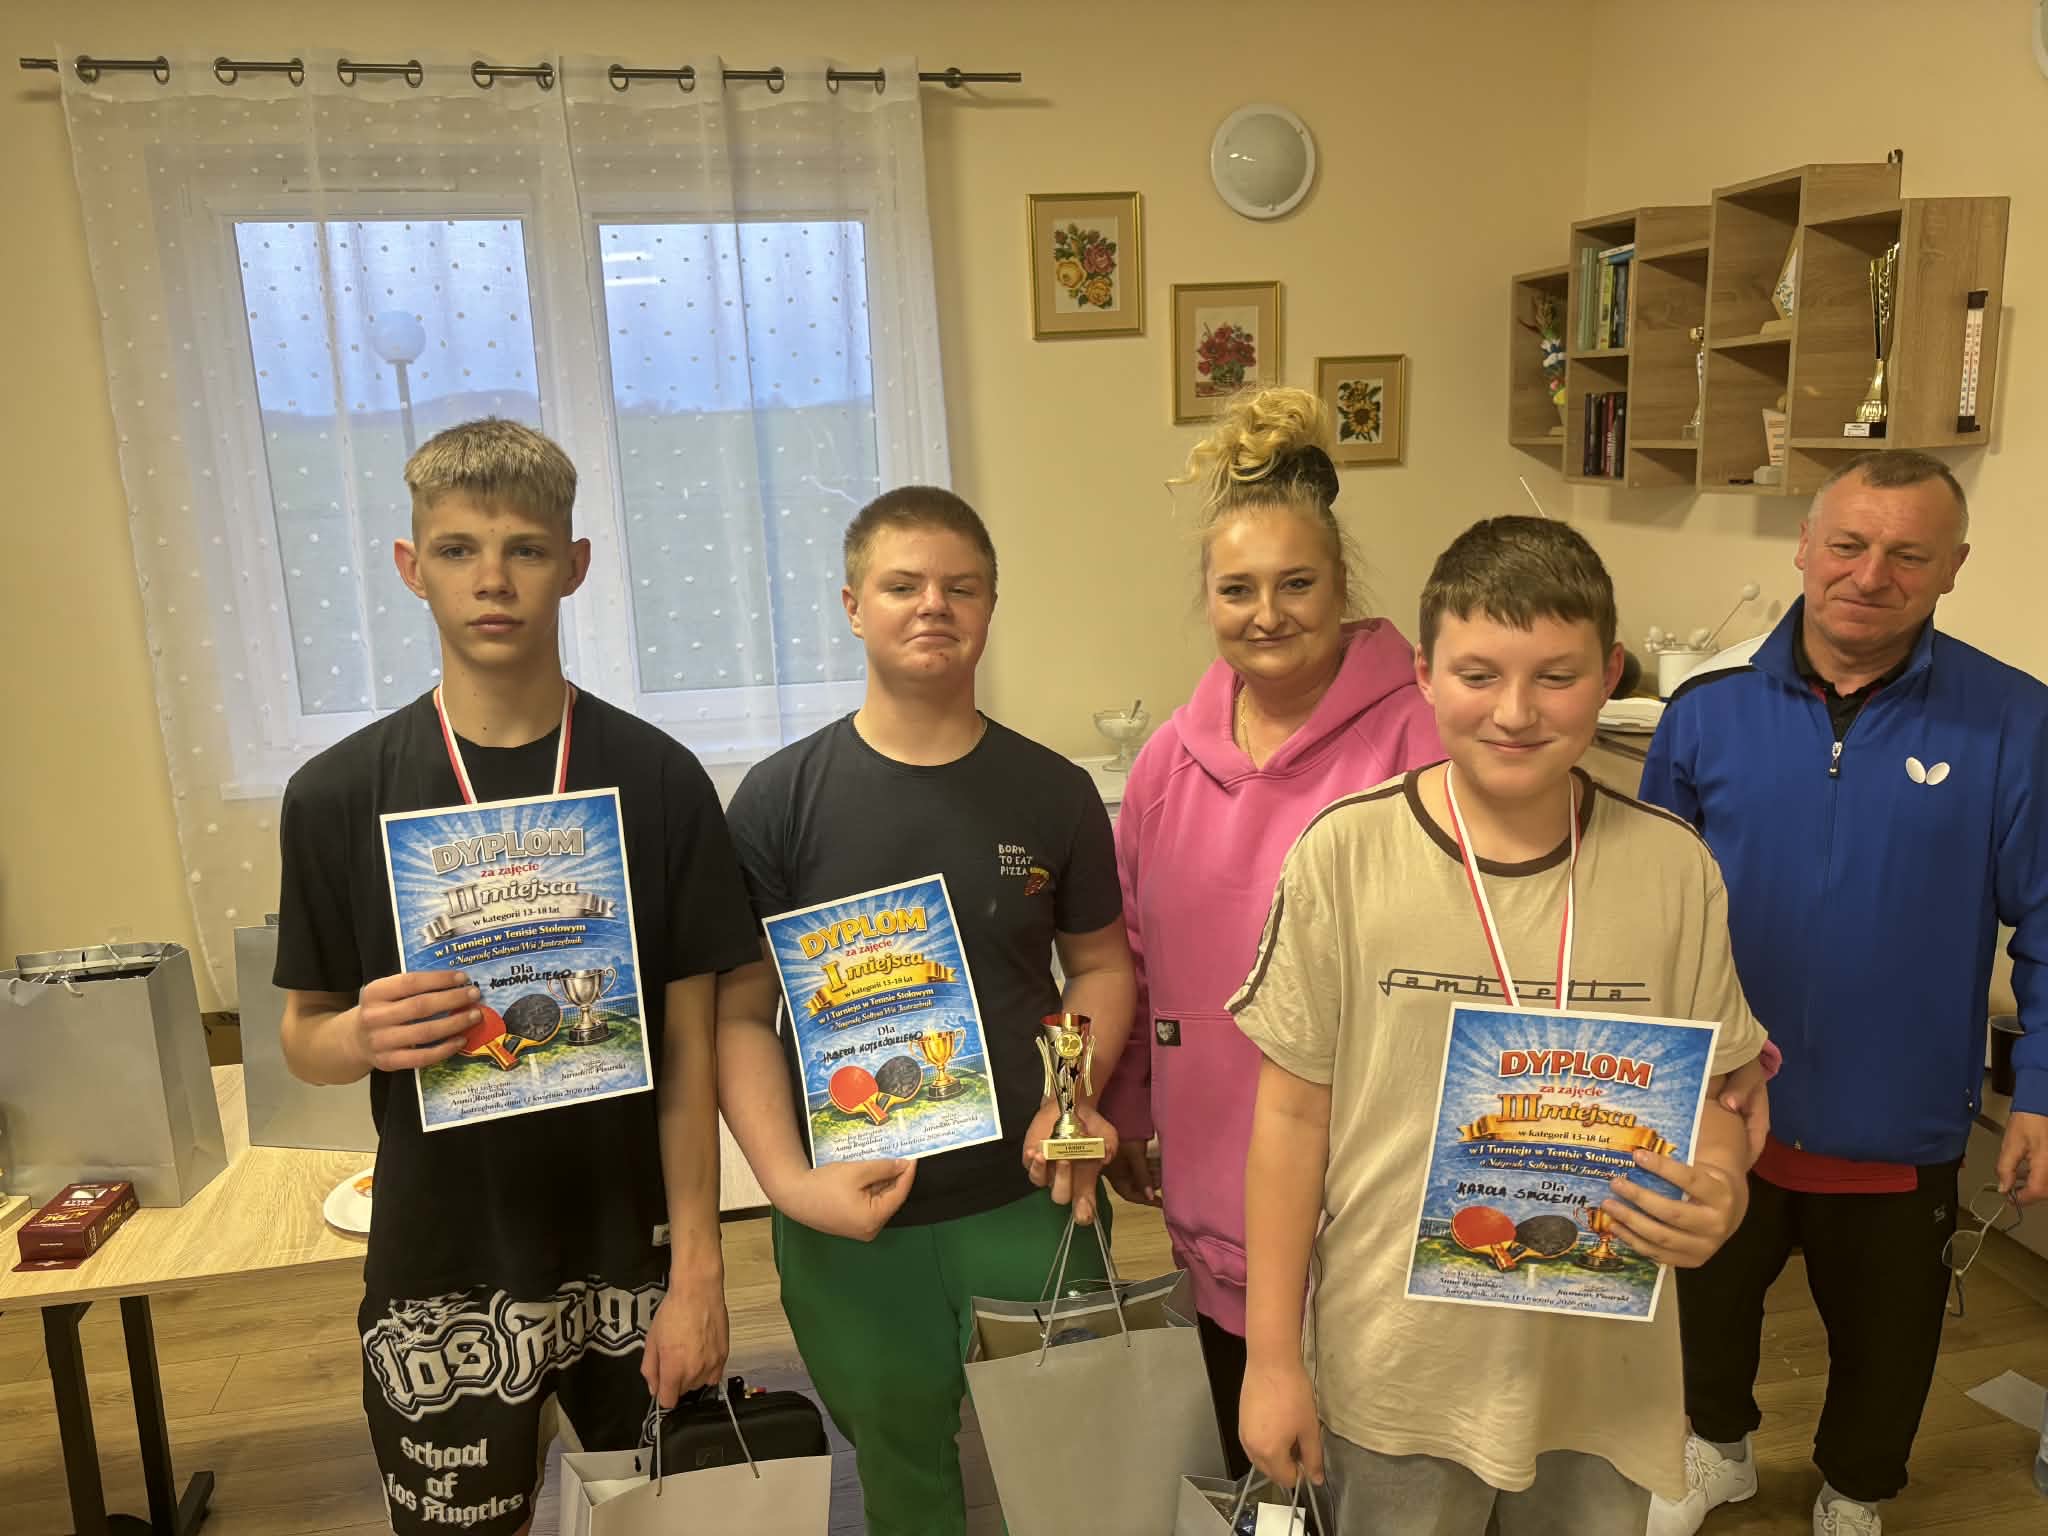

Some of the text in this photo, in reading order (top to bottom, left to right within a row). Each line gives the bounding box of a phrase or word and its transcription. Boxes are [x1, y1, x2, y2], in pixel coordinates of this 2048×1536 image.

[431, 827, 585, 875] DYPLOM
[998, 843, 1026, 854] BORN
[998, 855, 1034, 865] TO EAT
[480, 863, 540, 878] za zajęcie
[1000, 866, 1029, 876] PIZZA
[444, 878, 578, 918] II miejsca
[472, 919, 482, 927] w
[482, 911, 521, 925] kategorii
[546, 906, 560, 914] lat
[800, 907, 927, 959] DYPLOM
[434, 949, 444, 958] w
[451, 936, 492, 952] Turnieju
[494, 933, 503, 941] w
[503, 926, 538, 940] Tenisie
[845, 939, 893, 957] za zajęcie
[510, 963, 534, 976] Dla
[822, 952, 925, 992] I miejsca
[903, 975, 913, 983] lat
[878, 1025, 896, 1036] Dla
[1498, 1049, 1654, 1089] DYPLOM
[1539, 1085, 1604, 1098] za zajęcie
[1496, 1093, 1637, 1128] III miejsca
[1527, 1128, 1570, 1141] kategorii
[1572, 1132, 1596, 1143] 13-18
[1598, 1135, 1611, 1144] lat
[1469, 1147, 1479, 1155] w
[1487, 1144, 1532, 1158] Turnieju
[1535, 1149, 1545, 1157] w
[1546, 1147, 1582, 1160] Tenisie
[1456, 1181, 1507, 1198] KAROLA
[1541, 1180, 1566, 1192] Dla
[426, 1471, 459, 1499] of
[420, 1493, 524, 1529] Angeles
